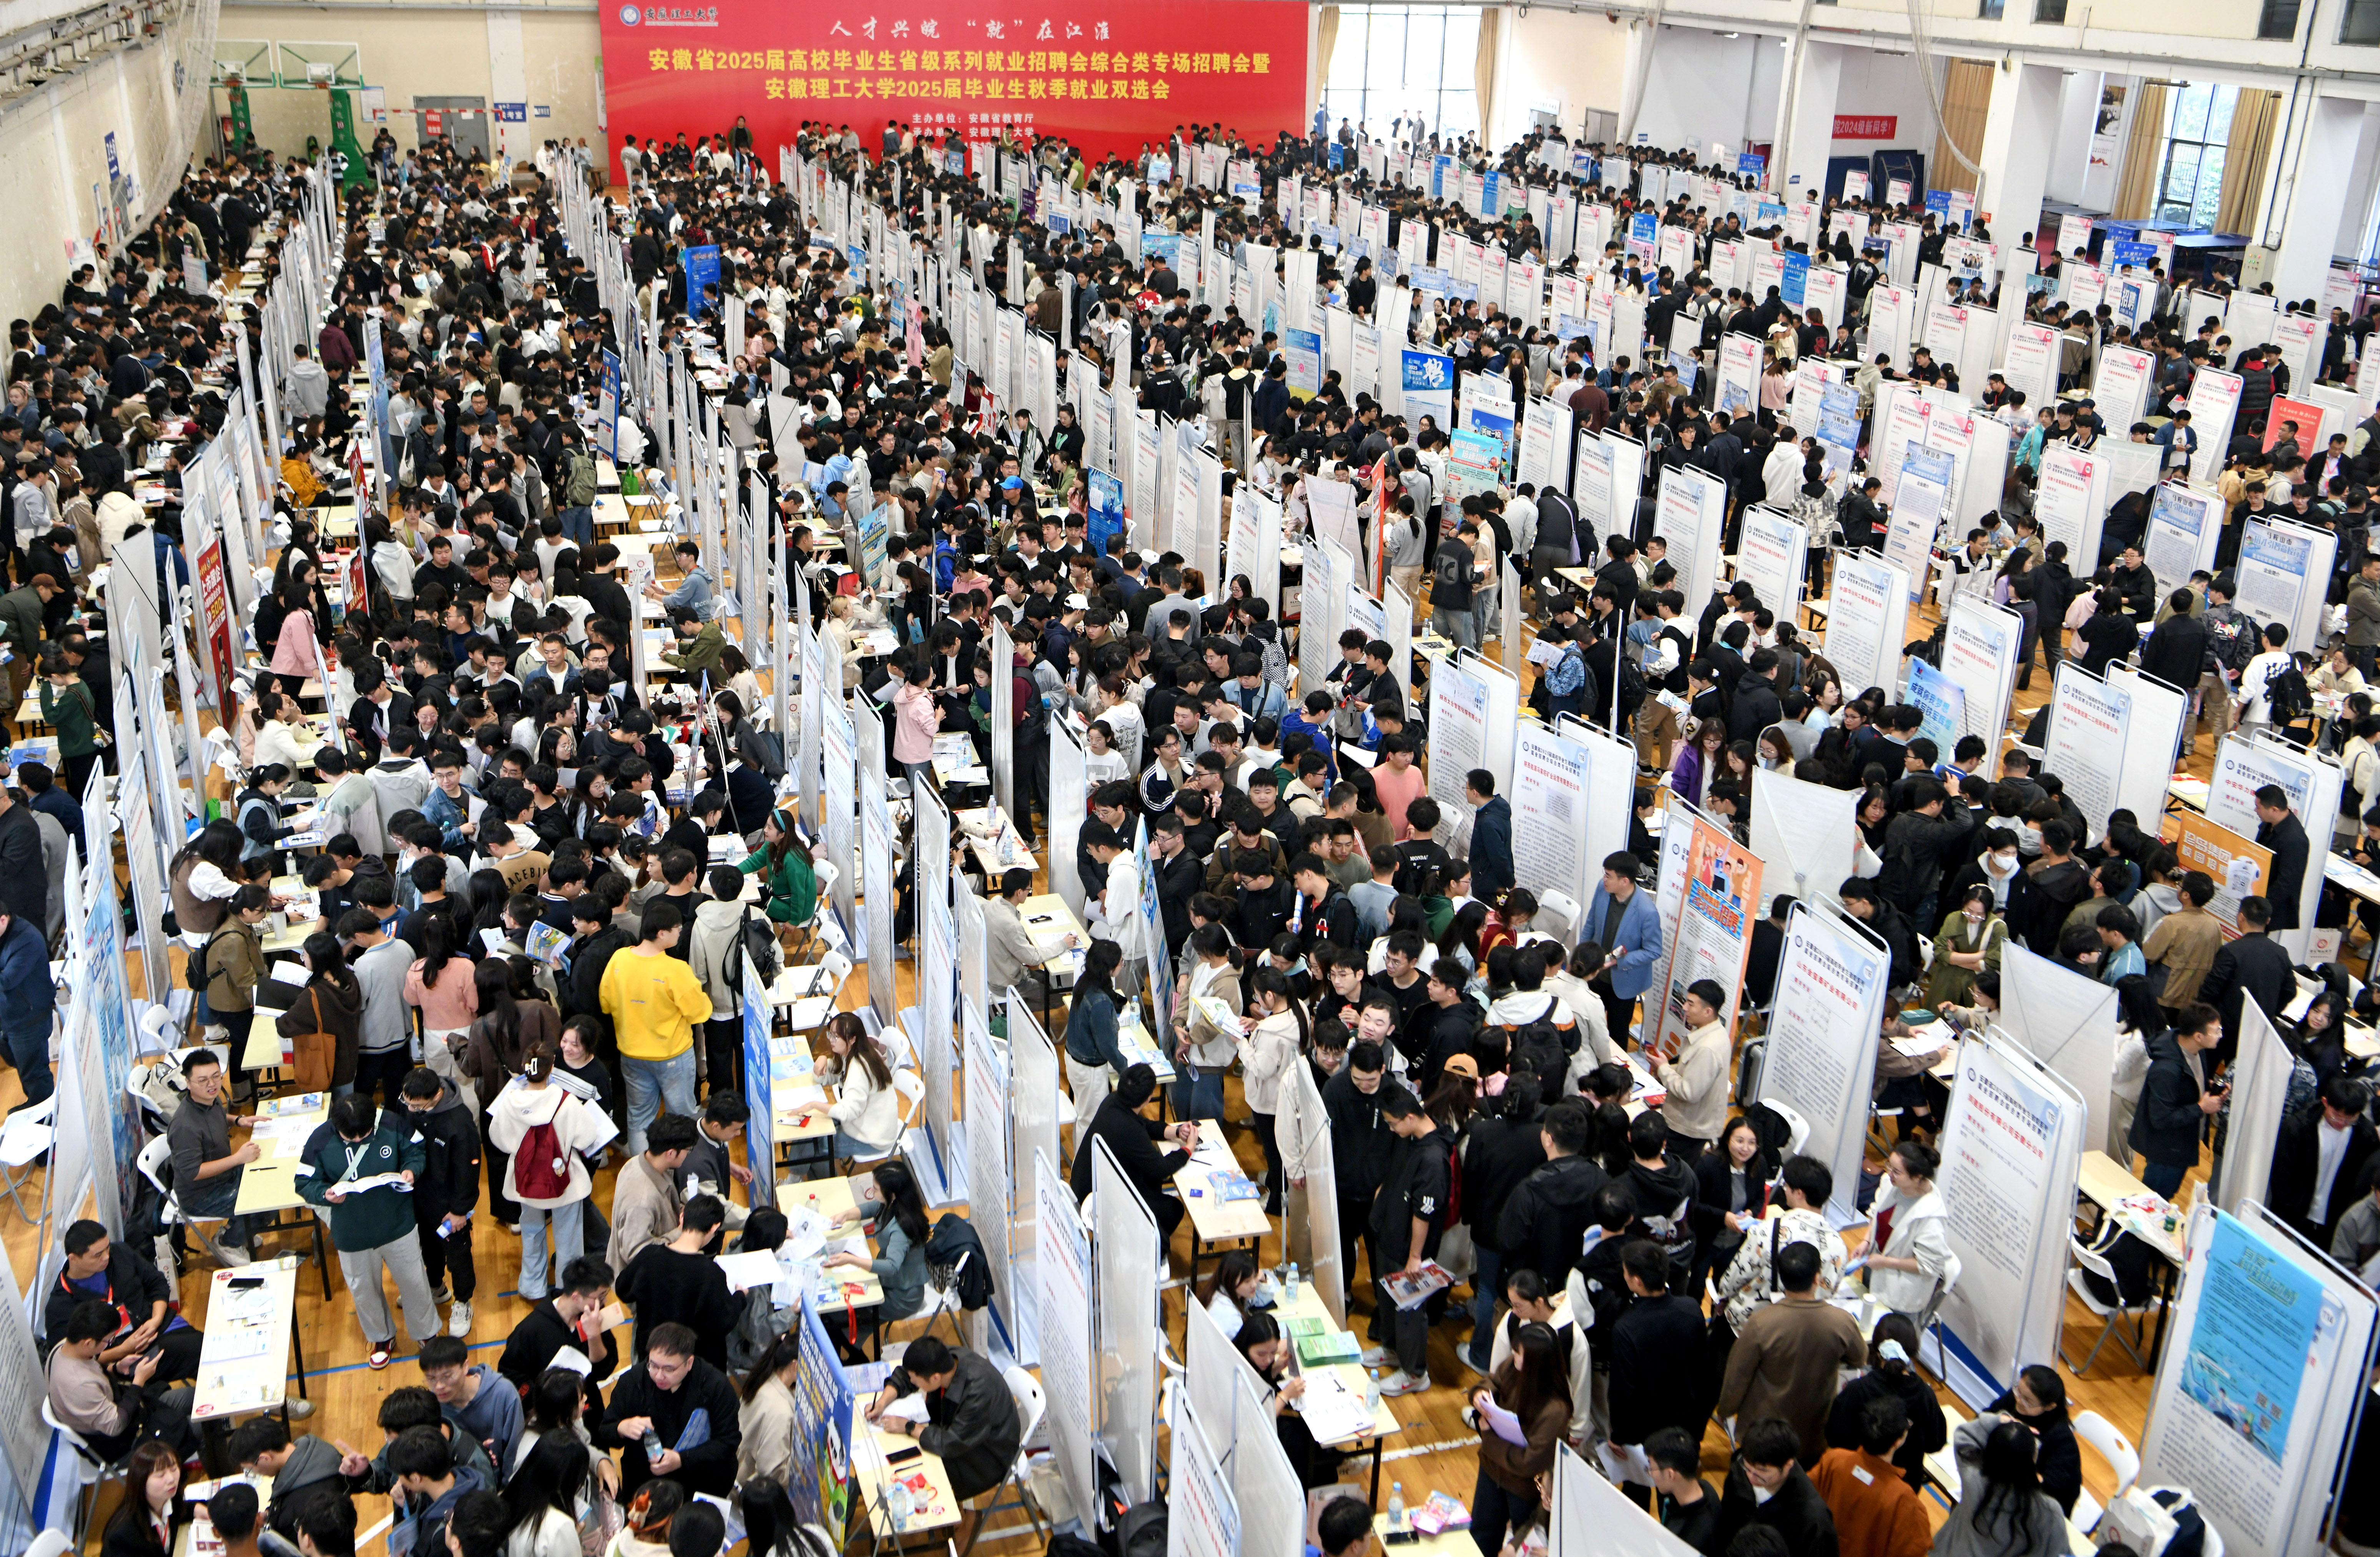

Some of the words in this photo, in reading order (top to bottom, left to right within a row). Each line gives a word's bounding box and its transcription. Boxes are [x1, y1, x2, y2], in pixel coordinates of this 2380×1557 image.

[830, 17, 940, 40] 人才兴皖
[649, 49, 1270, 73] 安徽省2025届高校毕业生省级系列就业招聘会综合类专场招聘会暨
[766, 78, 1169, 100] 安徽理工大学2025届毕业生秋季就业双选会
[969, 113, 1034, 124] 安徽省教育厅
[969, 128, 1034, 137] 安徽理大学
[2042, 279, 2053, 287] 你在
[2121, 288, 2136, 311] 招聘
[1921, 448, 1941, 460] 马鞍山市
[2172, 495, 2193, 507] 马鞍山市
[2266, 532, 2292, 546] 马鞍山市
